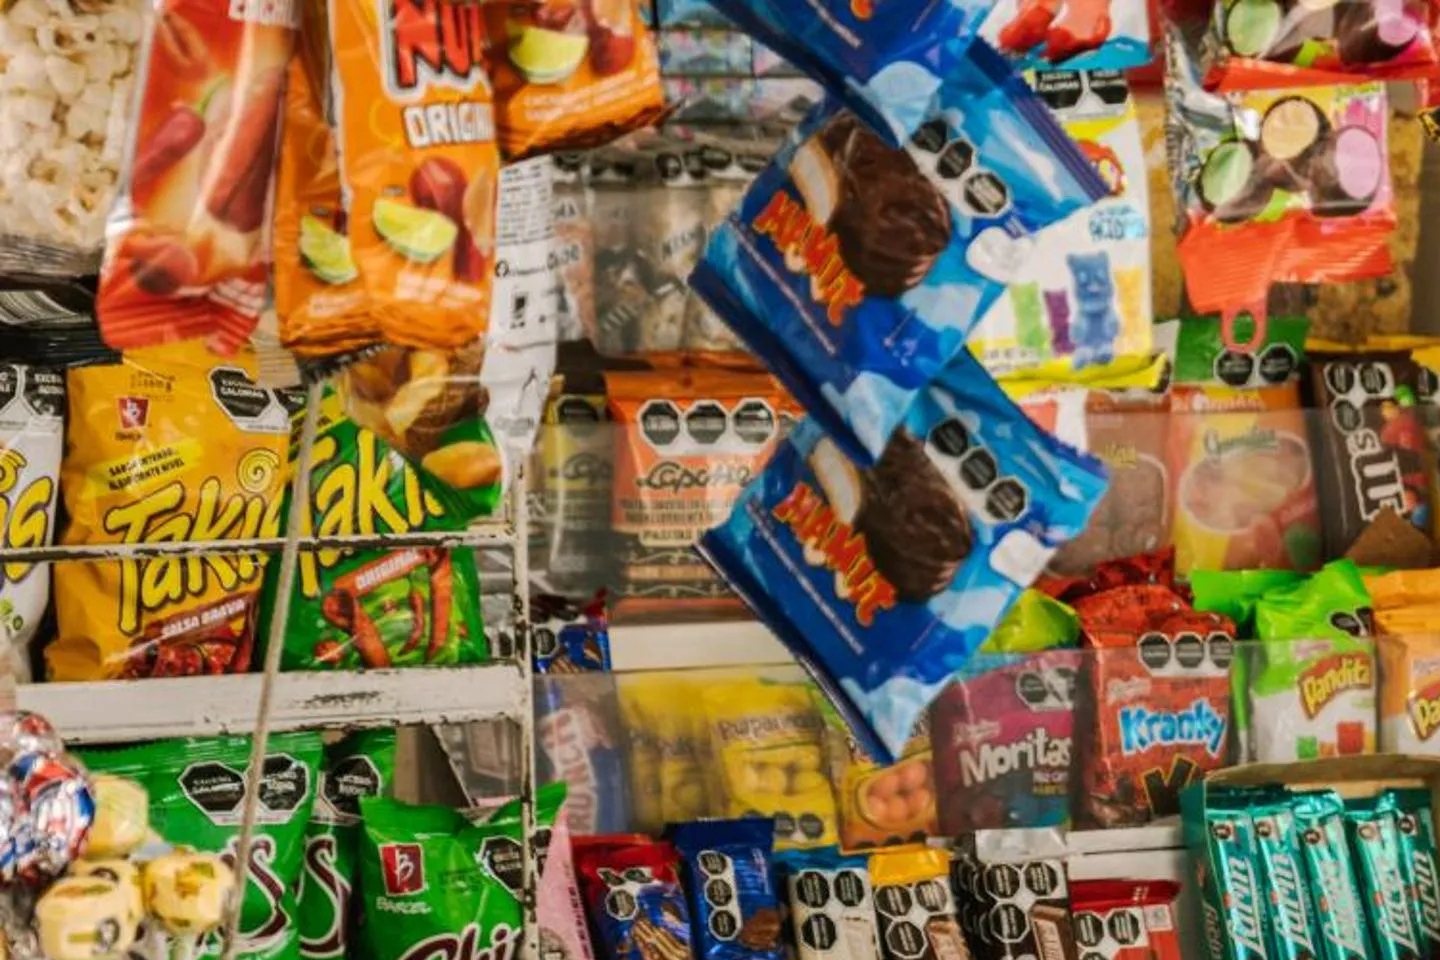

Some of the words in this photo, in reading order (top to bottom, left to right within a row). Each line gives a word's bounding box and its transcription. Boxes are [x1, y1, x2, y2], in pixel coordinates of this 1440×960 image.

[1302, 656, 1373, 717] Pandita
[959, 728, 1073, 786] Moritas
[1120, 703, 1226, 757] Kranky
